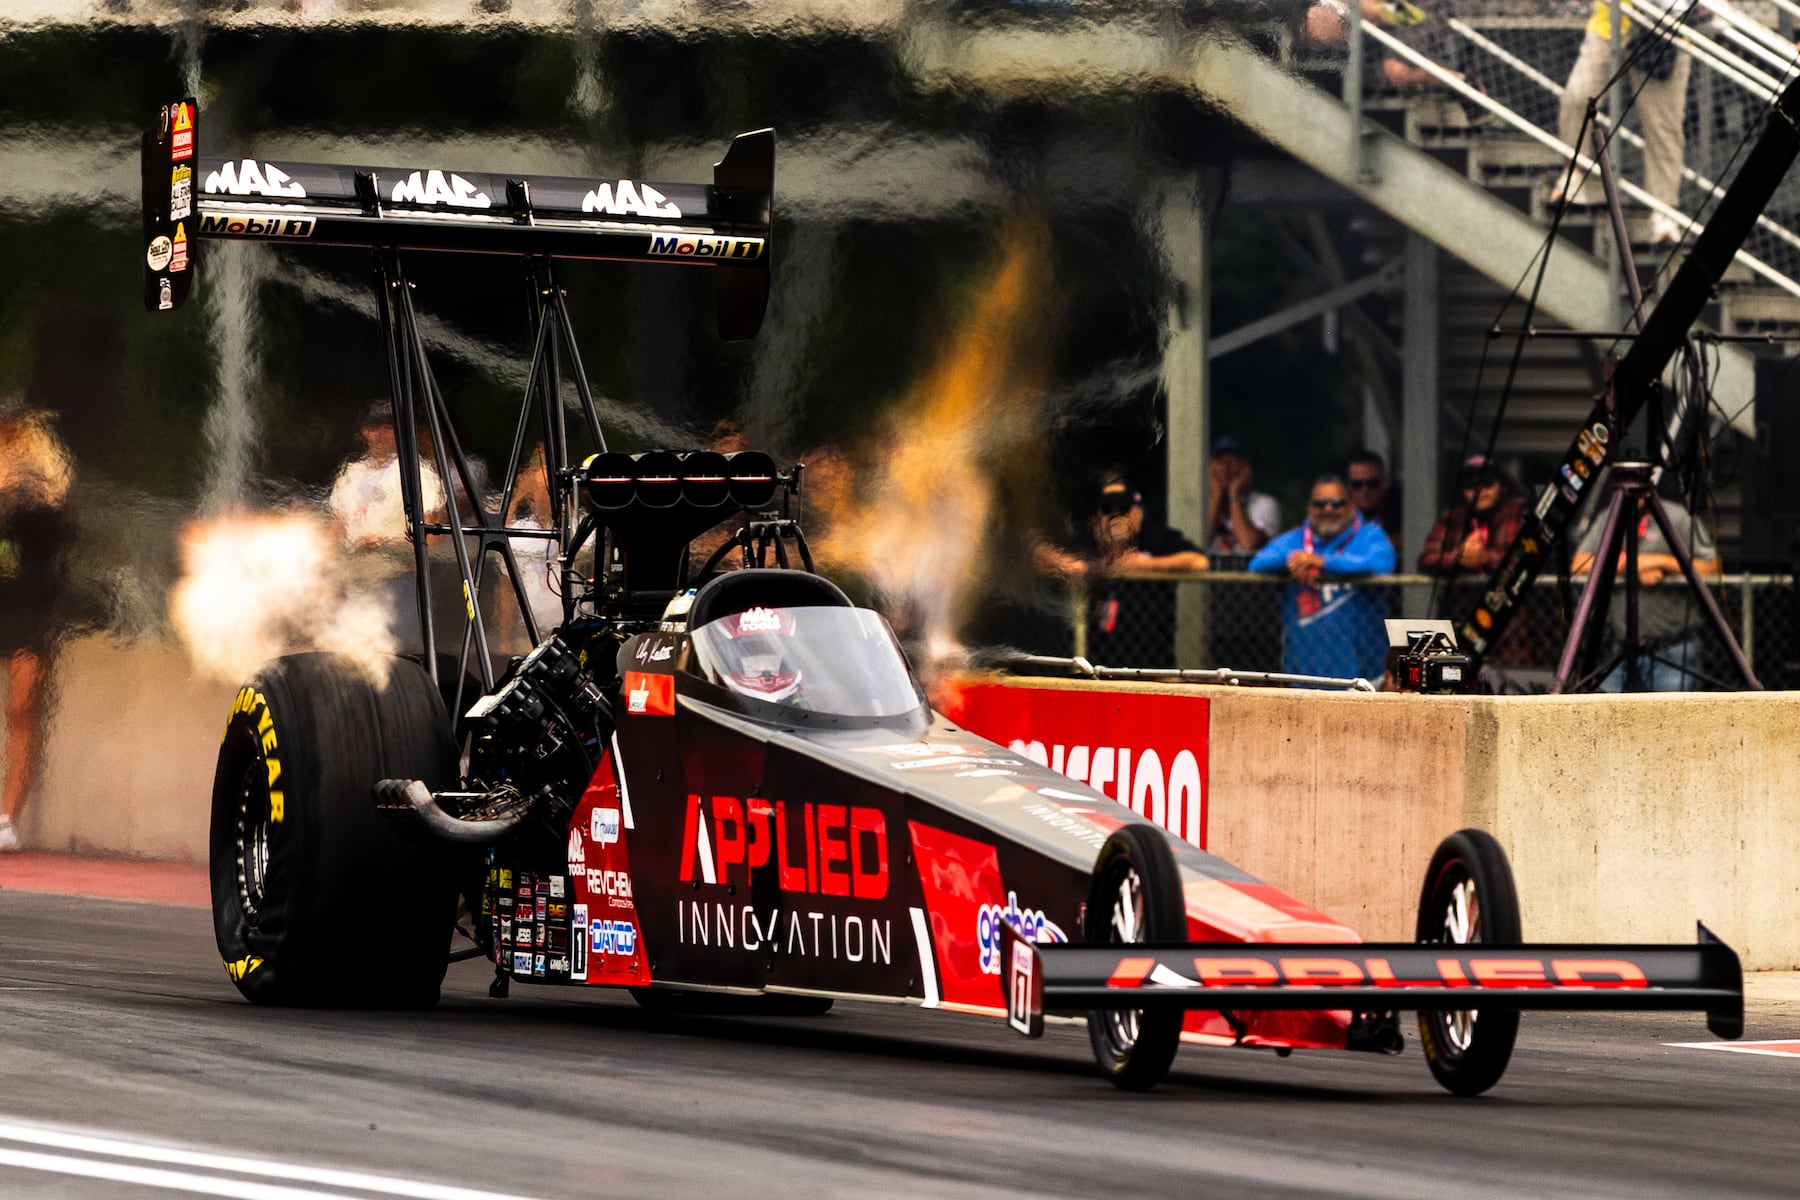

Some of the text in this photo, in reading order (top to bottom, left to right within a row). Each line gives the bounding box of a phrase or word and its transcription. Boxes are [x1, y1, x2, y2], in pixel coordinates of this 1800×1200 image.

[205, 158, 306, 198] MAC
[391, 169, 491, 209] MAC
[582, 179, 682, 219] MAC
[202, 215, 281, 236] Mobil
[652, 237, 730, 257] Mobil
[568, 827, 586, 863] MAC
[680, 794, 889, 899] APPLIED
[568, 863, 586, 876] TOOLS
[591, 918, 636, 956] DAYCO
[679, 900, 891, 965] INNOVATION
[1106, 957, 1648, 988] APPLIED
